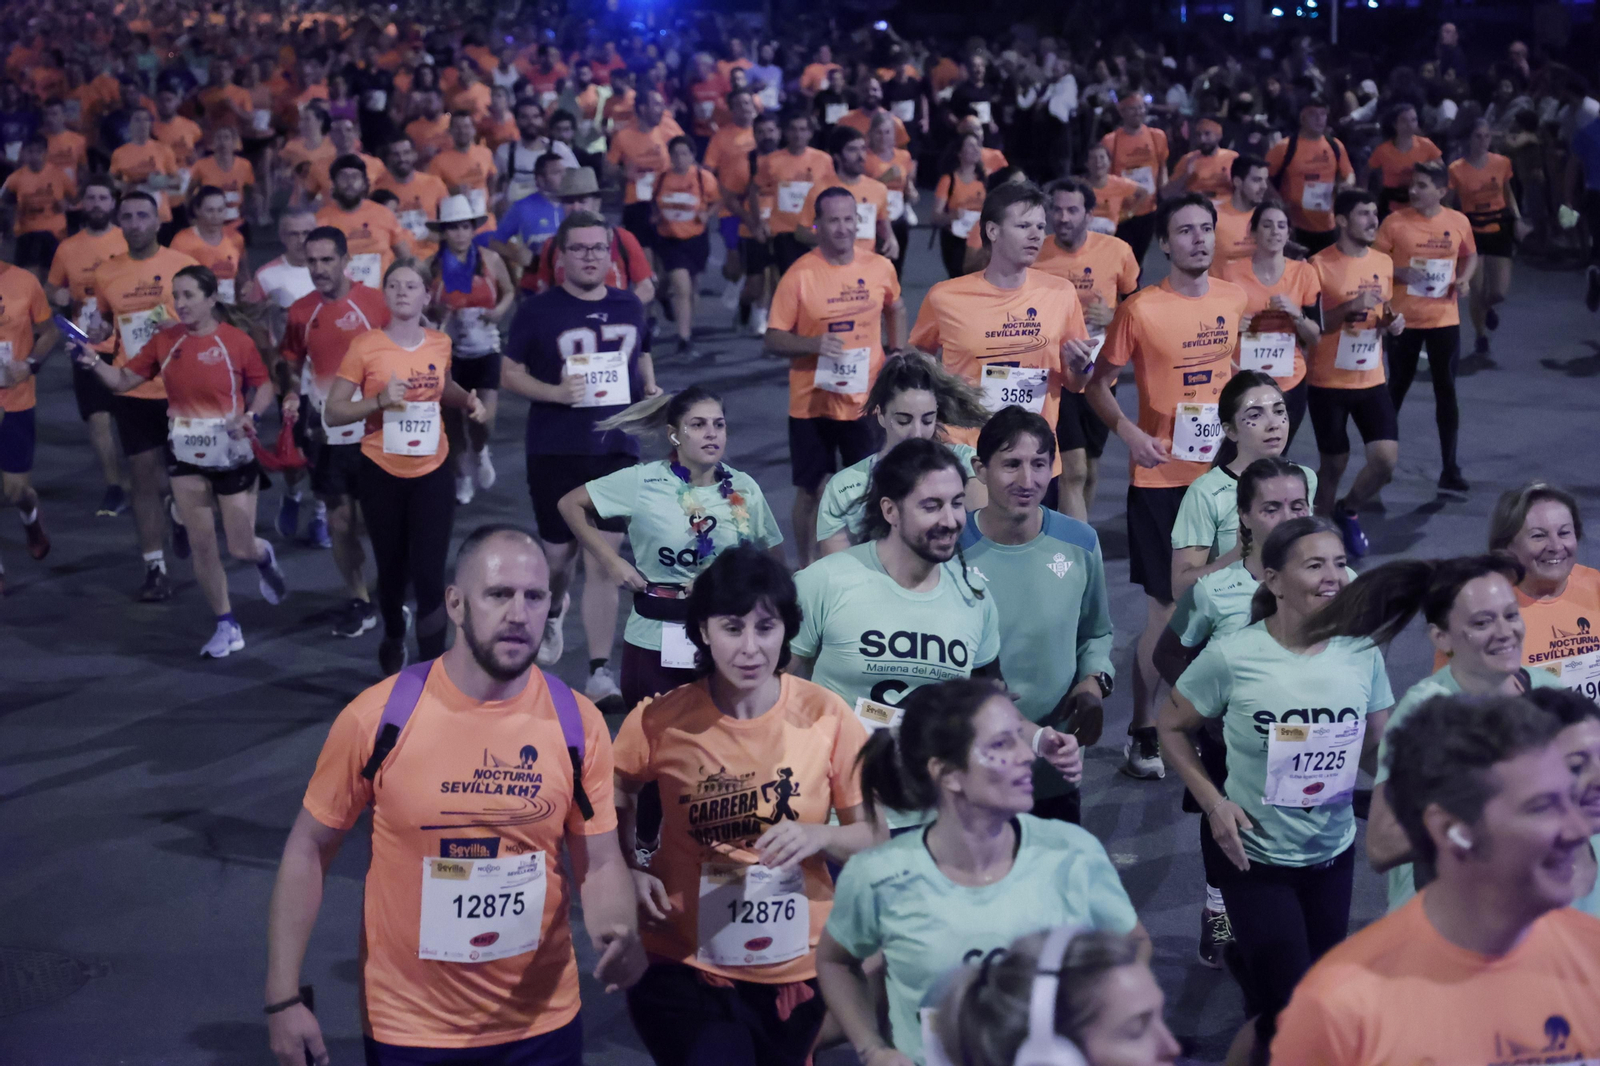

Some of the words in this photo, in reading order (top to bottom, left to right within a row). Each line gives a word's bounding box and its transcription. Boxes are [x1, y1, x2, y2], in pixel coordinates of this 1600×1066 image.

[1002, 321, 1042, 329] NOCTURNA
[985, 329, 1020, 338] SEVILLA
[1197, 330, 1229, 339] NOCTURNA
[1182, 339, 1213, 348] SEVILLA
[1253, 347, 1285, 359] 17747
[585, 370, 619, 384] 18728
[1001, 387, 1034, 404] 3585
[398, 419, 432, 433] 18727
[1194, 423, 1220, 437] 3600
[859, 629, 968, 668] sano
[1549, 636, 1600, 649] NOCTURNA
[1528, 648, 1575, 664] SEVILLA
[866, 663, 909, 673] Mairena
[911, 665, 928, 675] del
[1292, 750, 1347, 772] 17225
[473, 768, 543, 783] NOCTURNA
[440, 781, 503, 796] SEVILLA
[689, 790, 758, 826] CARRERA
[452, 891, 526, 919] 12875
[727, 898, 796, 924] 12876
